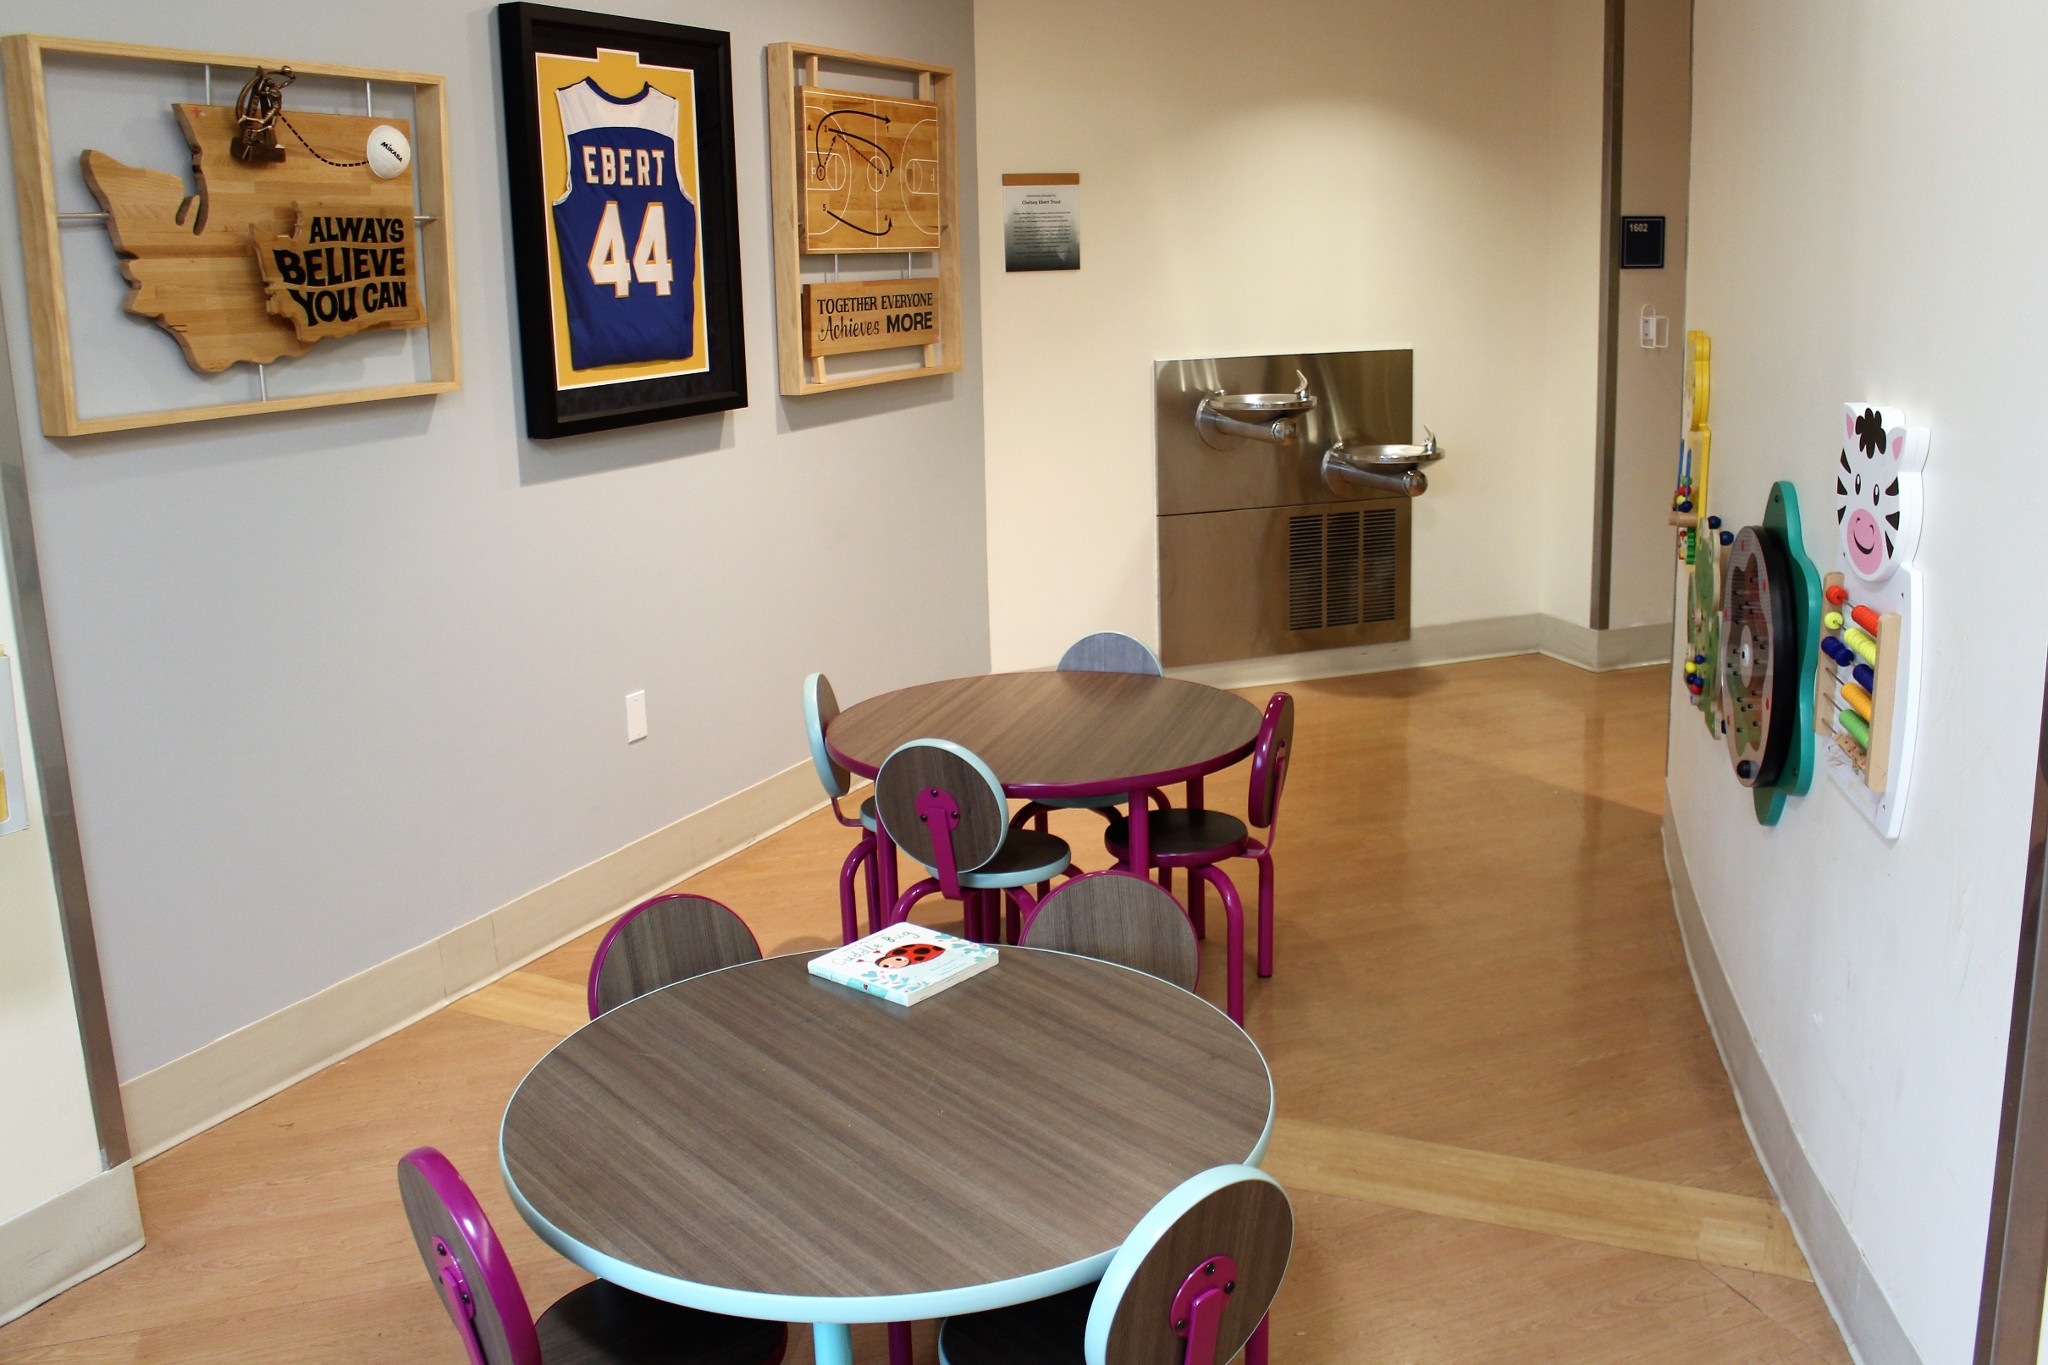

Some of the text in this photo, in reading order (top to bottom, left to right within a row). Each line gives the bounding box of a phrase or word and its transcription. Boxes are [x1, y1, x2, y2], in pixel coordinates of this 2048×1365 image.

[582, 145, 665, 186] EBERT
[309, 216, 405, 245] ALWAYS
[1629, 223, 1649, 233] 1602
[272, 247, 406, 287] BELIEVE
[587, 200, 674, 299] 44
[287, 281, 408, 327] YOU CAN
[817, 292, 934, 315] TOGETHER EVERYONE
[818, 311, 934, 342] Achieves MORE
[831, 943, 884, 966] Cuddle
[881, 931, 921, 943] Bug
